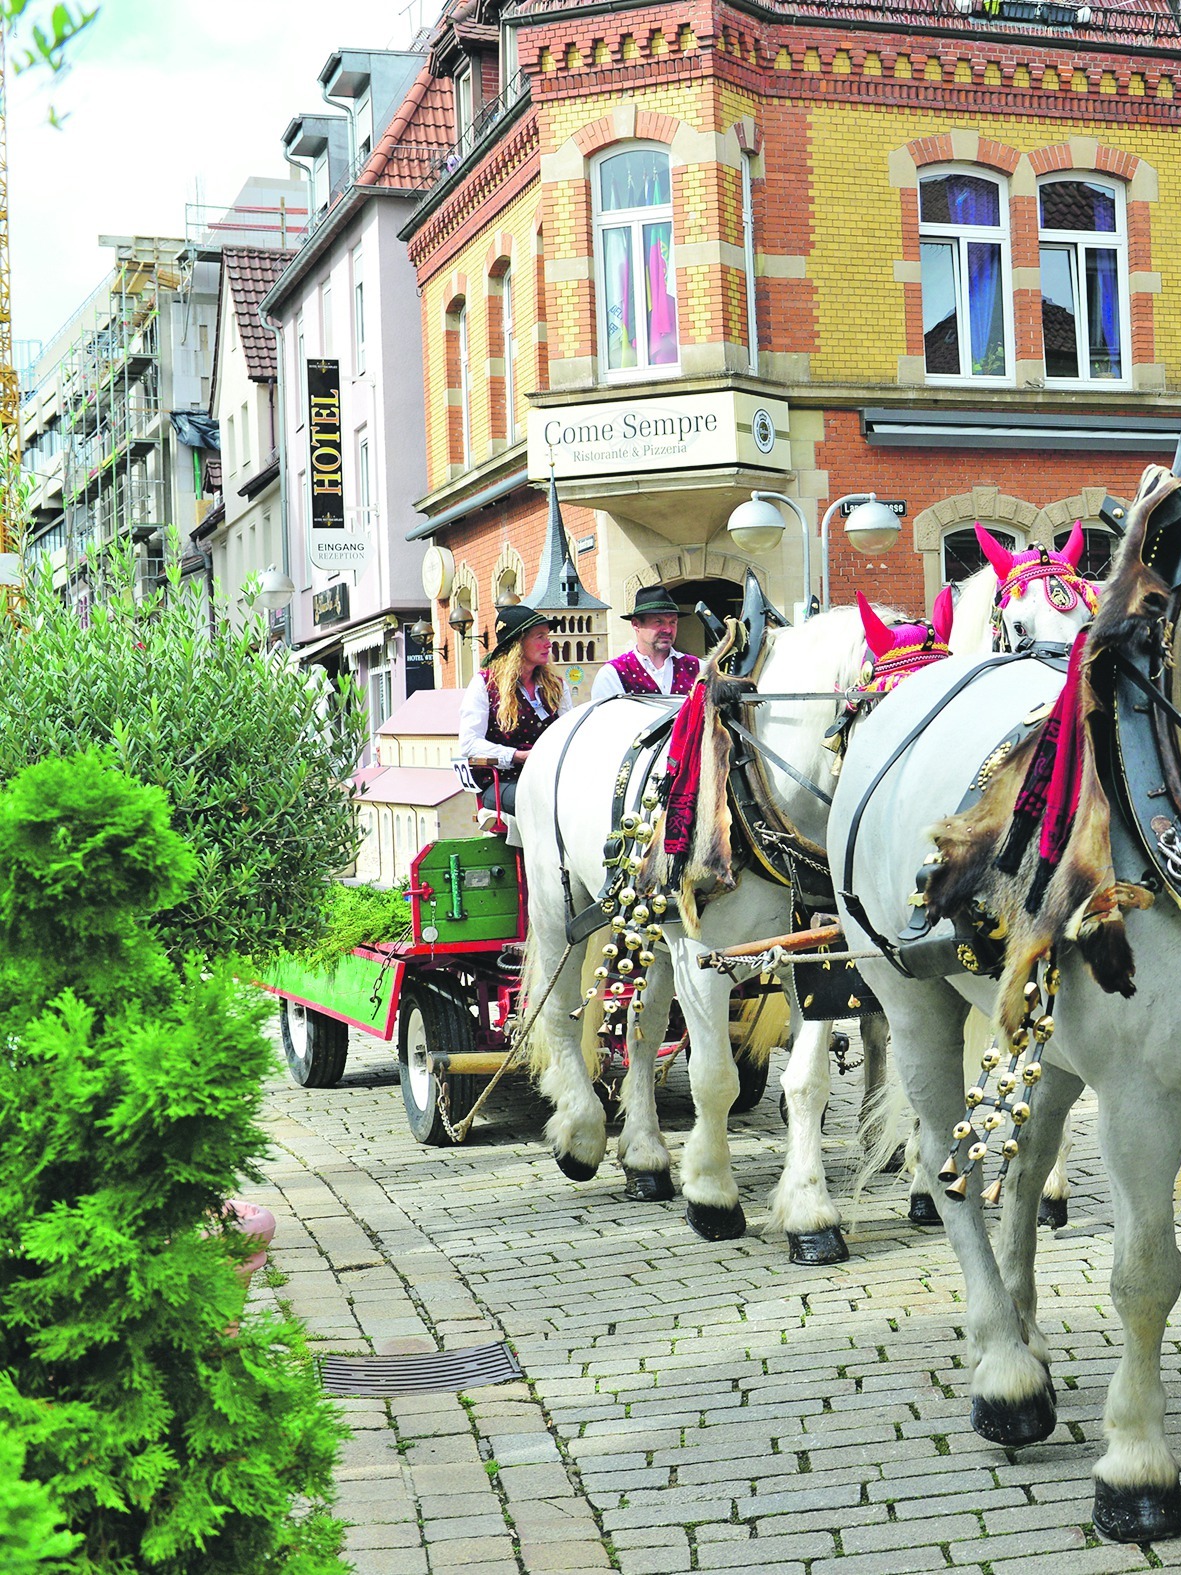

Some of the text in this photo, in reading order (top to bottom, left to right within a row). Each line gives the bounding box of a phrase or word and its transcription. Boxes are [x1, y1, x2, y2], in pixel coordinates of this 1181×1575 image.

[544, 413, 717, 446] Come Sempre
[311, 388, 342, 496] HOTEL
[573, 442, 687, 462] Ristorante & Pizzeria
[317, 543, 365, 551] EINGANG
[318, 552, 365, 560] REZEPTION
[406, 654, 424, 662] HOTEL
[454, 763, 476, 788] 22
